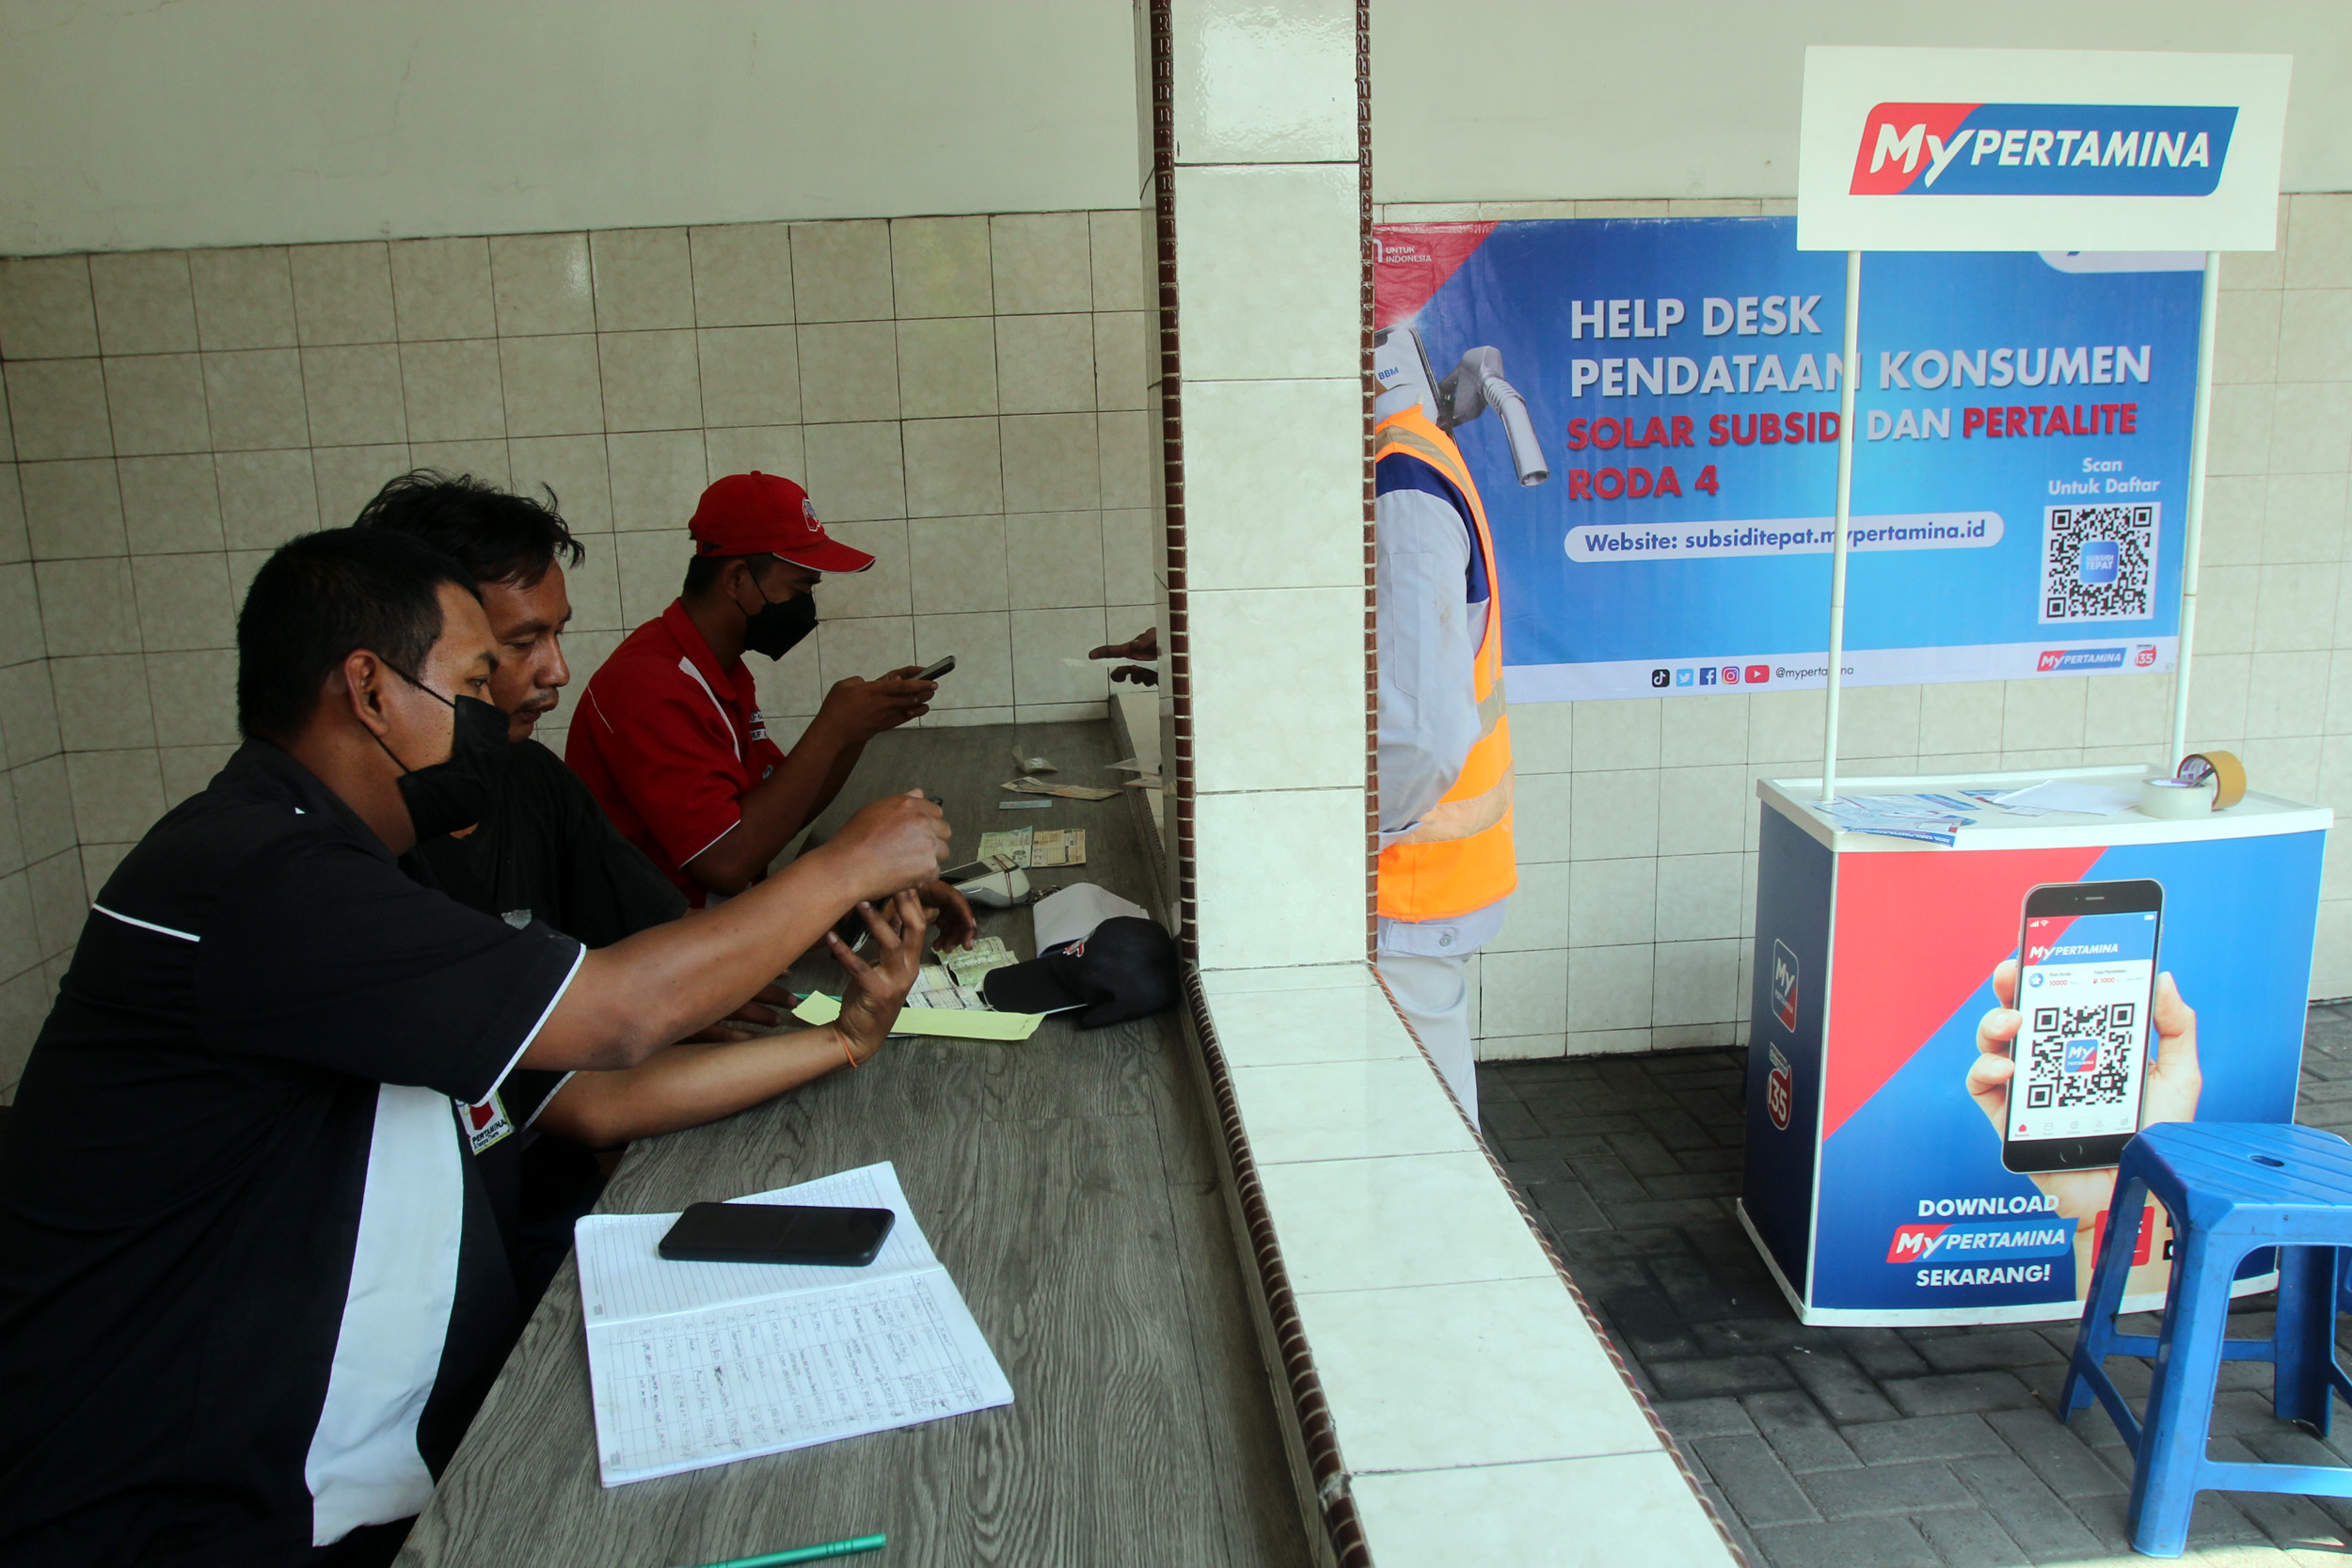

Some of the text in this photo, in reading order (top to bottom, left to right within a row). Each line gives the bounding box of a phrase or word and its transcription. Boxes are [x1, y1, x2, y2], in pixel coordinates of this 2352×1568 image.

[1385, 246, 1416, 255] UNTUK
[1386, 255, 1432, 263] INDONESIA
[1571, 294, 1822, 340] HELP DESK
[1378, 367, 1399, 380] BBM
[1571, 345, 2152, 398] PENDATAAN KONSUMEN
[1567, 403, 2137, 451] SOLAR SUBSID DAN PERTALITE
[2082, 457, 2123, 472] Scan
[1568, 465, 1719, 500] RODA 4
[2048, 476, 2161, 495] Untuk Daftar
[1584, 519, 1985, 552] Website: subsiditepat.mpertamina.id
[2086, 562, 2114, 570] TEPAT
[2136, 653, 2153, 664] 135
[1775, 667, 1854, 680] @mypertana
[1769, 1074, 1788, 1121] 135
[472, 1119, 508, 1144] PERTAMINA
[1918, 1195, 2059, 1217] DOWNLOAD
[1915, 1264, 2051, 1287] SEKARANG!
